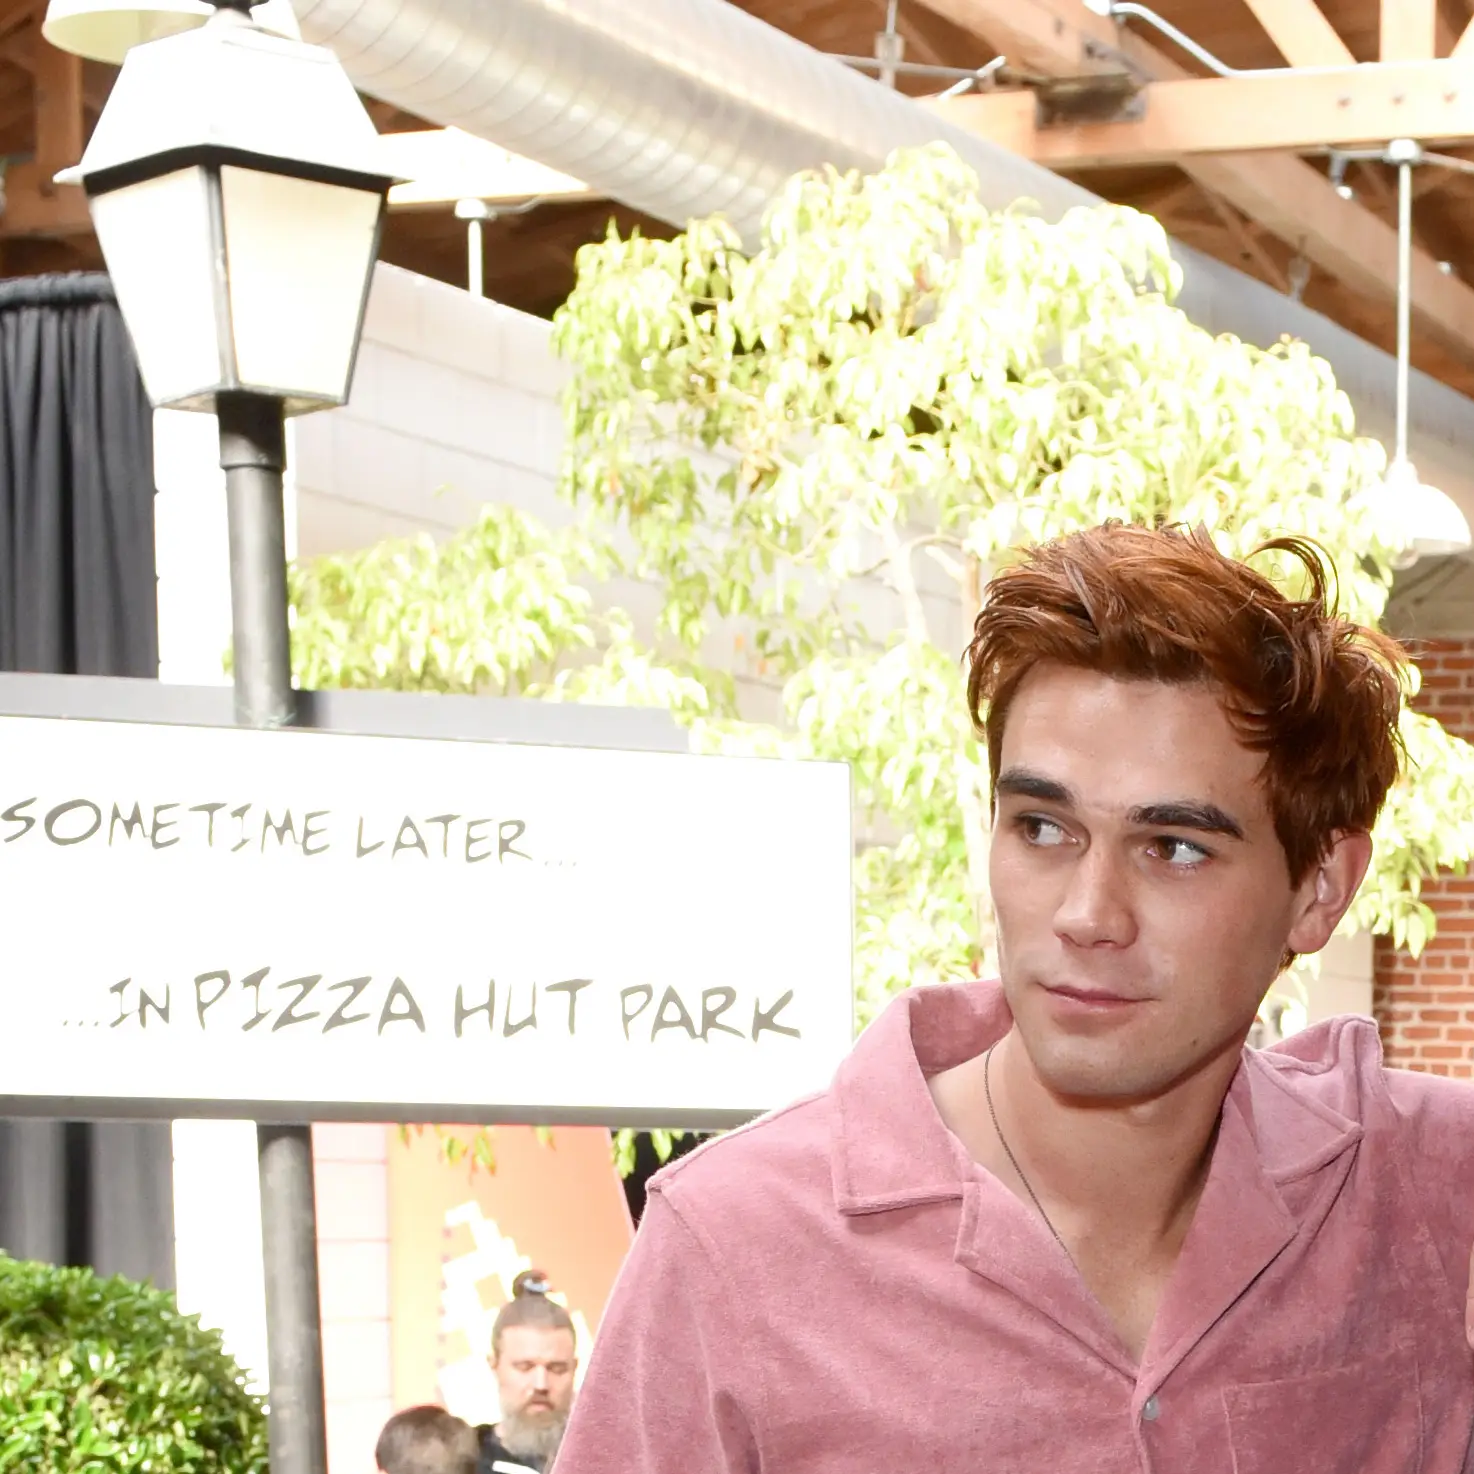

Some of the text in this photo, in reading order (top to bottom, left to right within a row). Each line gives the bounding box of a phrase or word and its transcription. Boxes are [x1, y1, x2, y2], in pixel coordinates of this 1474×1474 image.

[0, 797, 577, 867] SOMETIME LATER...
[193, 965, 426, 1037] PIZZA
[453, 978, 594, 1039] HUT
[619, 983, 802, 1044] PARK
